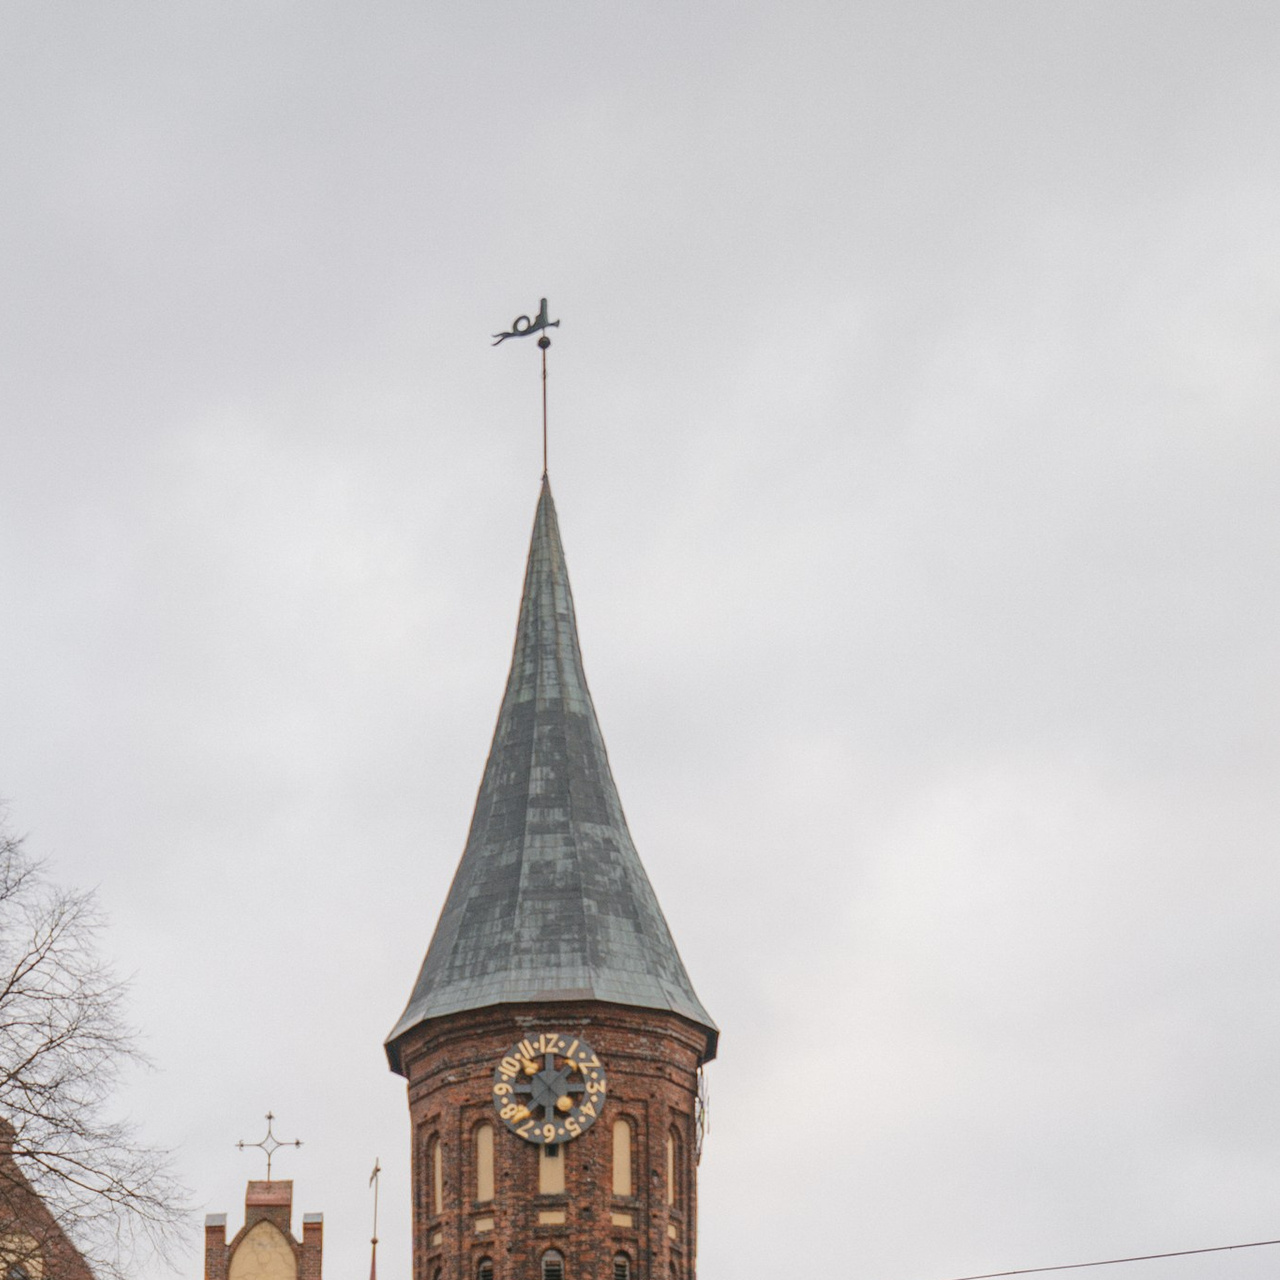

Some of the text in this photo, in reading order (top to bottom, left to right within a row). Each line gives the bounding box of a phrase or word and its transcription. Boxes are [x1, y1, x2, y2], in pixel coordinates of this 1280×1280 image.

[518, 1039, 536, 1059] 11
[566, 1039, 579, 1057] 1
[497, 1056, 521, 1078] 10
[493, 1082, 513, 1096] 9
[586, 1079, 606, 1094] 3
[500, 1103, 518, 1120] 8
[580, 1101, 597, 1118] 4
[515, 1119, 535, 1139] 7
[542, 1123, 556, 1143] 6
[564, 1116, 582, 1138] 5
